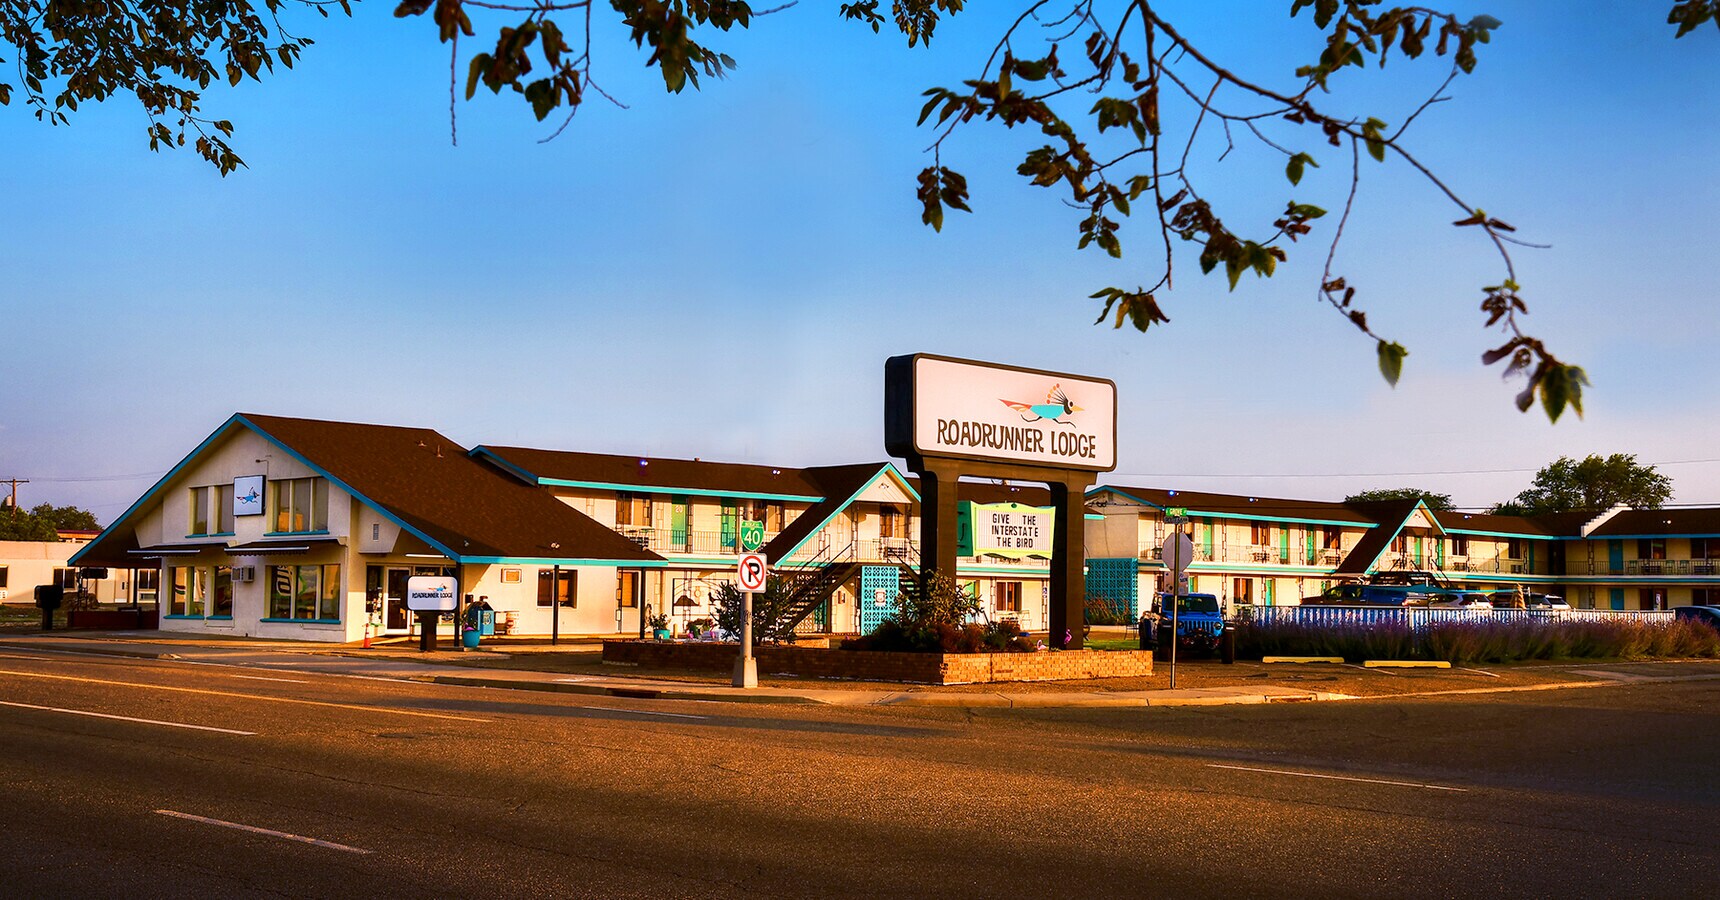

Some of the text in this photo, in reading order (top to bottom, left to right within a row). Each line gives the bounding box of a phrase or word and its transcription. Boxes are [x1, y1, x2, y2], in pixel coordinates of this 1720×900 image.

[937, 419, 1096, 458] ROADRUNNER LODGE
[992, 513, 1036, 525] GIVE THE
[991, 525, 1038, 537] INTERSTATE
[744, 530, 760, 545] 40
[996, 537, 1034, 548] THE BIRD
